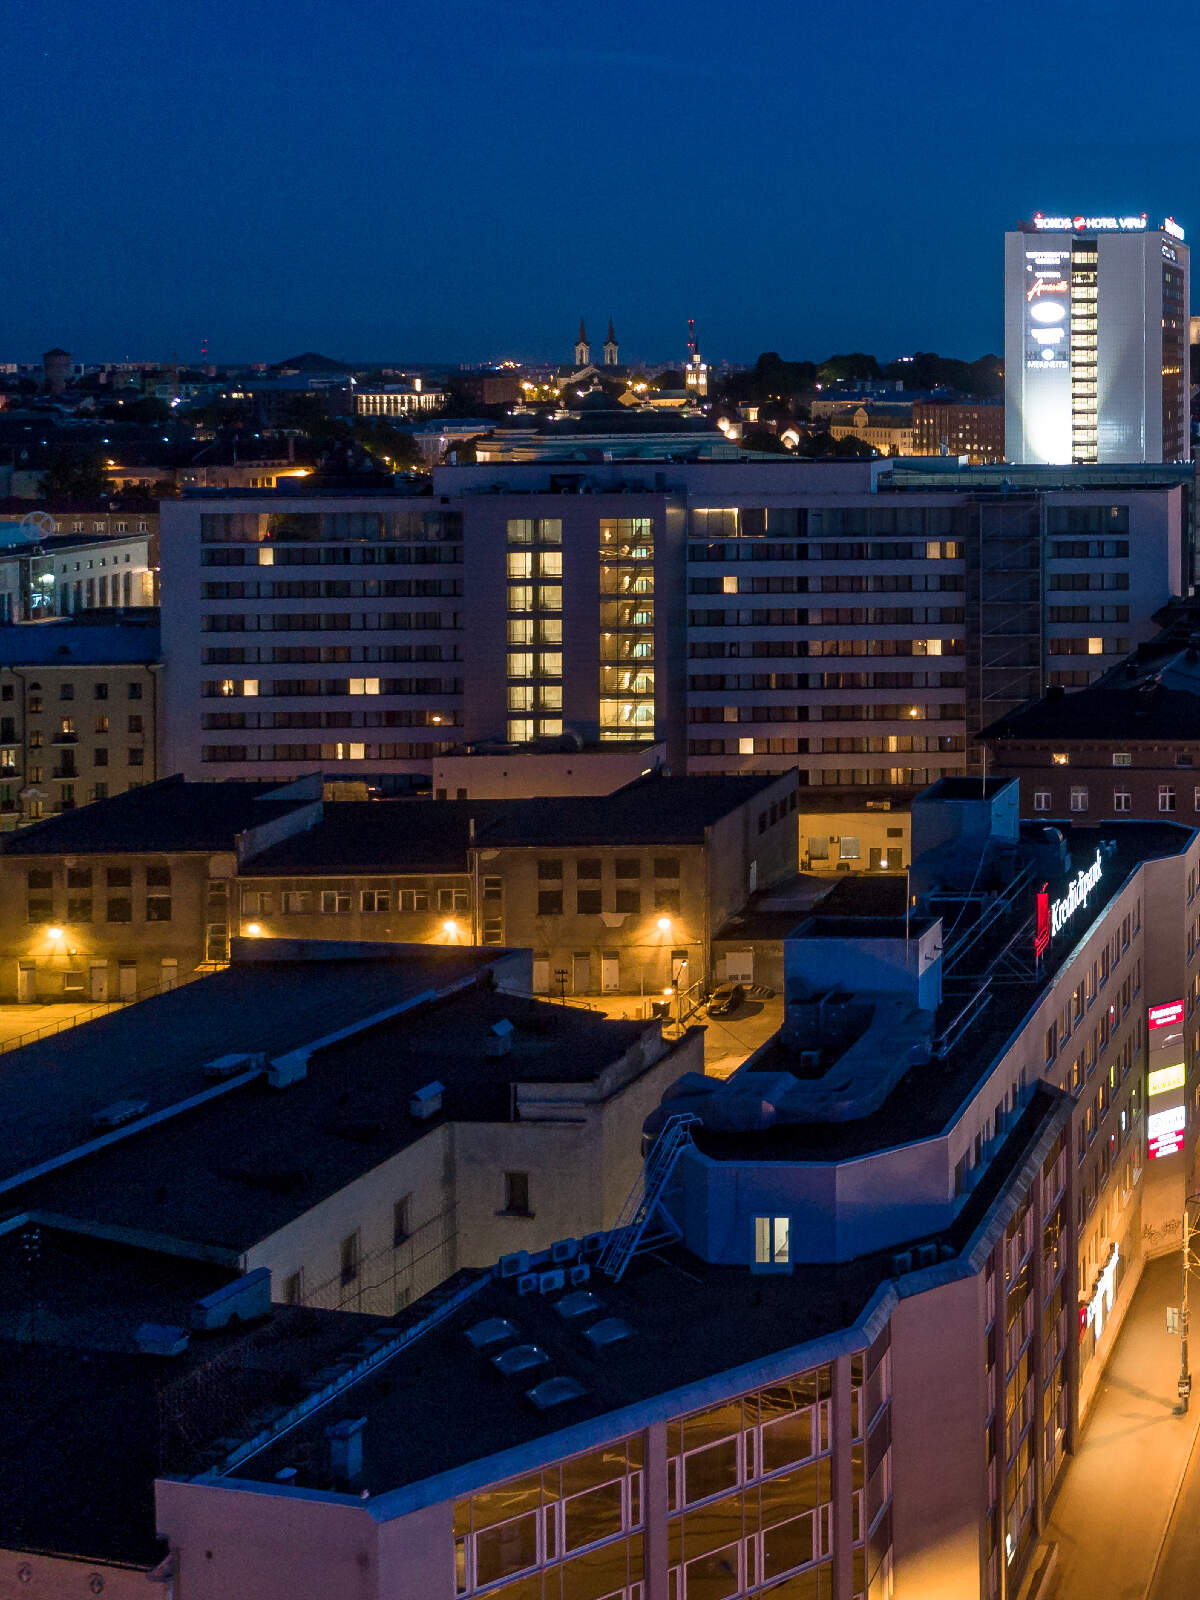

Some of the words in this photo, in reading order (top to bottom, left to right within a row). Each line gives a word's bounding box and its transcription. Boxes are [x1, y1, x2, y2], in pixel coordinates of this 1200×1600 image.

[1035, 217, 1072, 229] SOKOS
[1086, 217, 1118, 229] HOTEL
[1118, 217, 1146, 229] VIRU
